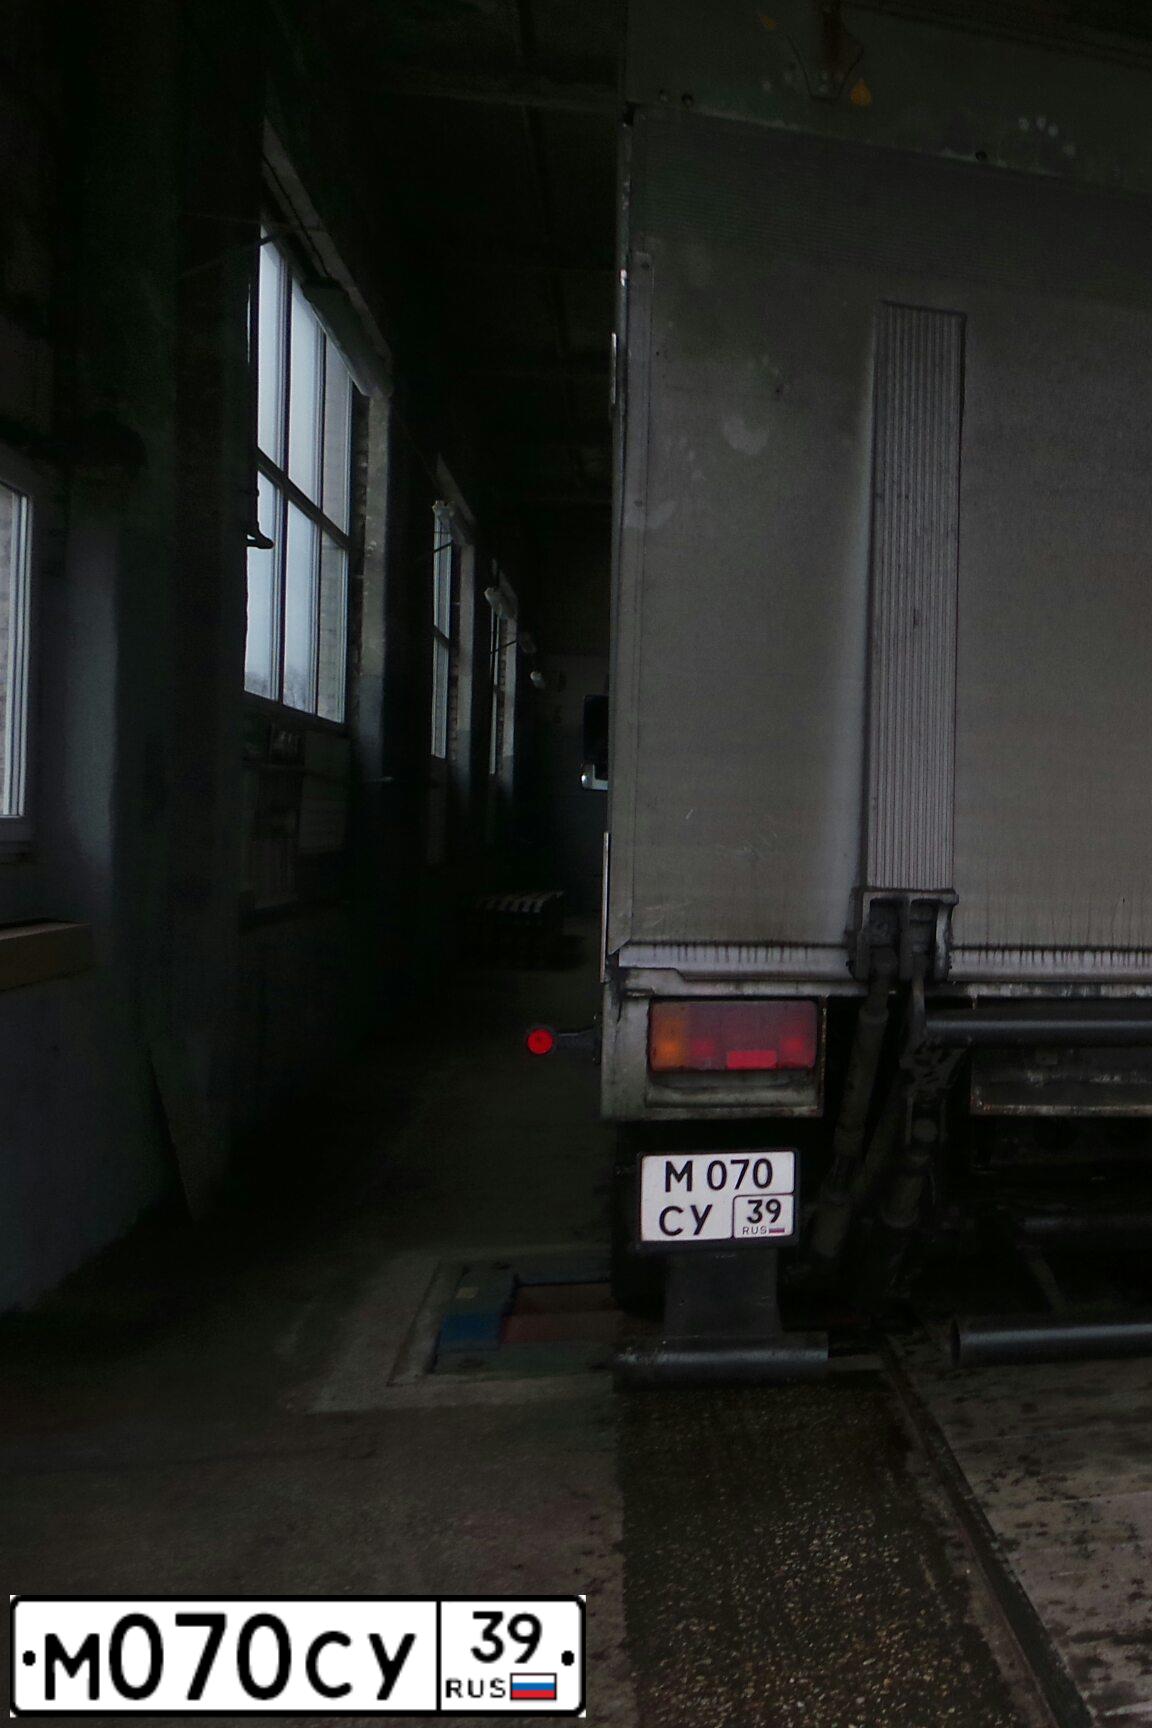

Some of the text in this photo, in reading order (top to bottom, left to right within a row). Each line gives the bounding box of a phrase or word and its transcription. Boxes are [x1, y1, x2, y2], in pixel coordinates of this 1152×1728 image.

[659, 1204, 713, 1236] СУ
[746, 1199, 782, 1224] 39
[742, 1226, 767, 1235] RUS
